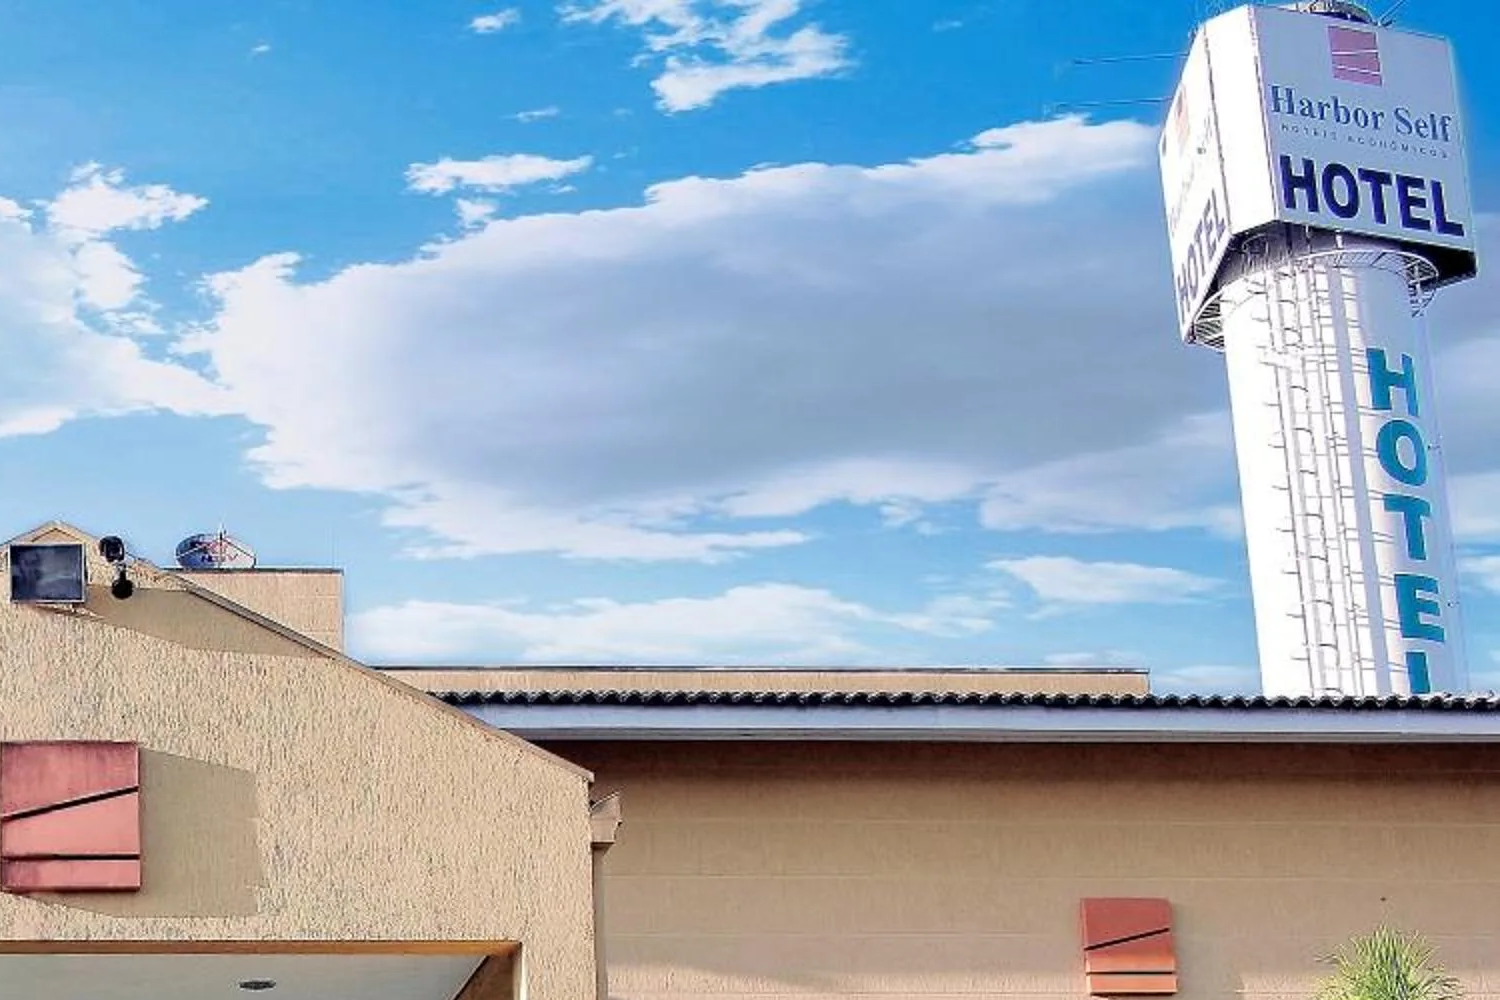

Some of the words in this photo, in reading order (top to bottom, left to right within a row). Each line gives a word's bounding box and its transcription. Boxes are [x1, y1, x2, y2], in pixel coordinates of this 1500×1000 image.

[1271, 85, 1385, 131] Harbor
[1393, 107, 1452, 142] Self
[1279, 155, 1465, 237] HOTEL
[1176, 188, 1227, 325] HOTEL
